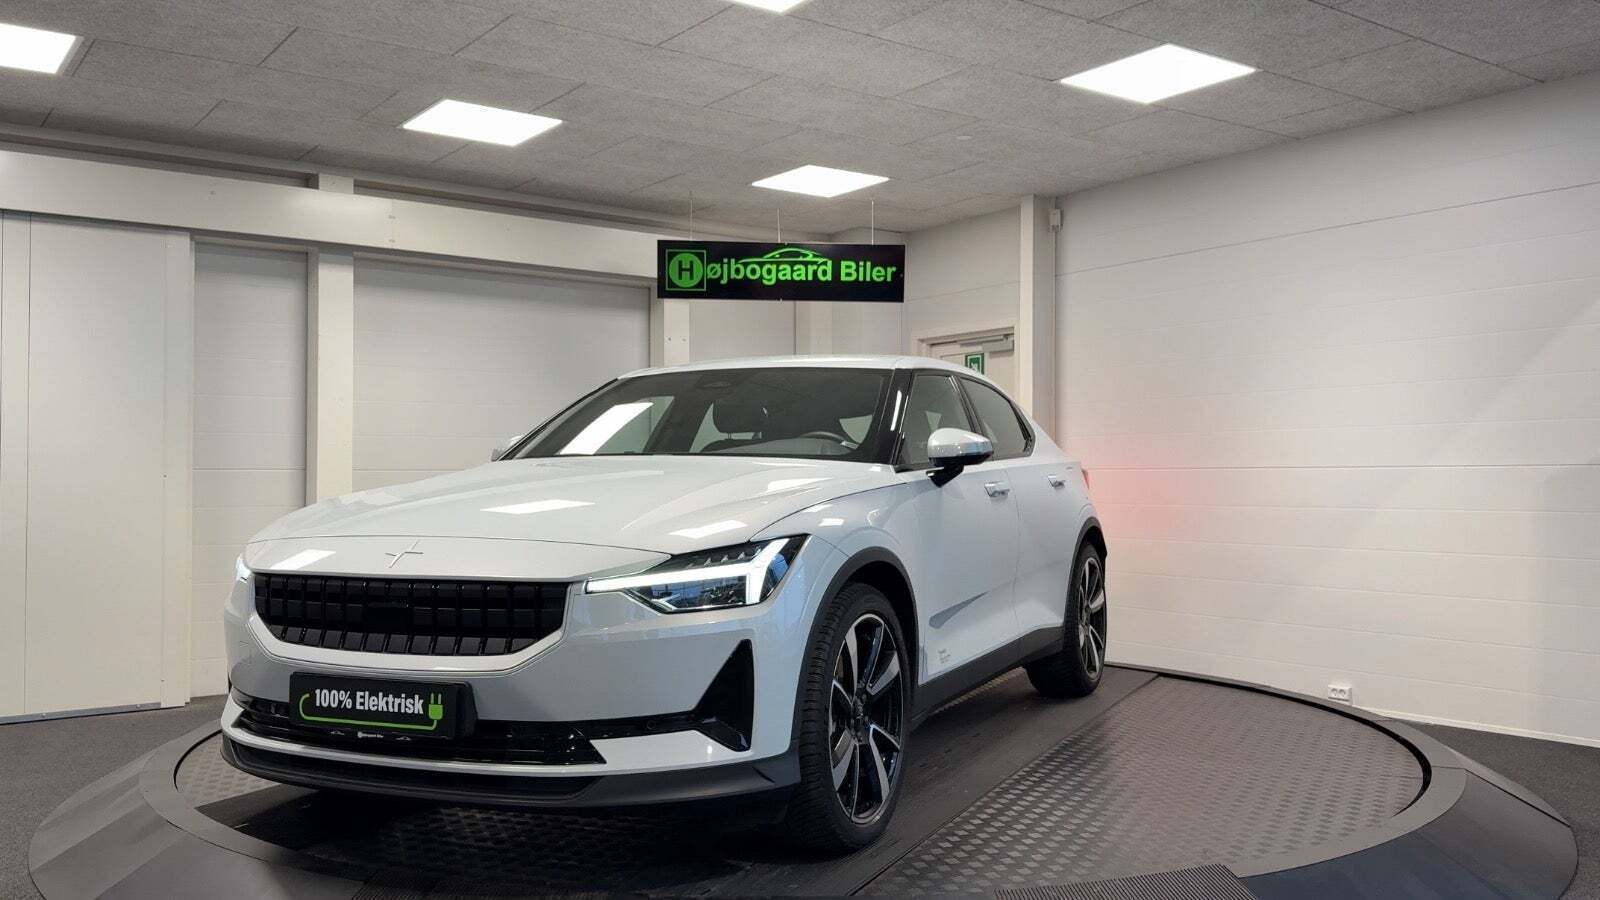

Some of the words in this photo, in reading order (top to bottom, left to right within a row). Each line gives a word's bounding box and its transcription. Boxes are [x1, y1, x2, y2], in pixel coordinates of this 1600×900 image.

[669, 251, 832, 288] Højbogaard
[840, 261, 897, 282] Biler
[314, 688, 352, 709] 100%
[355, 691, 424, 714] Elektrisk
